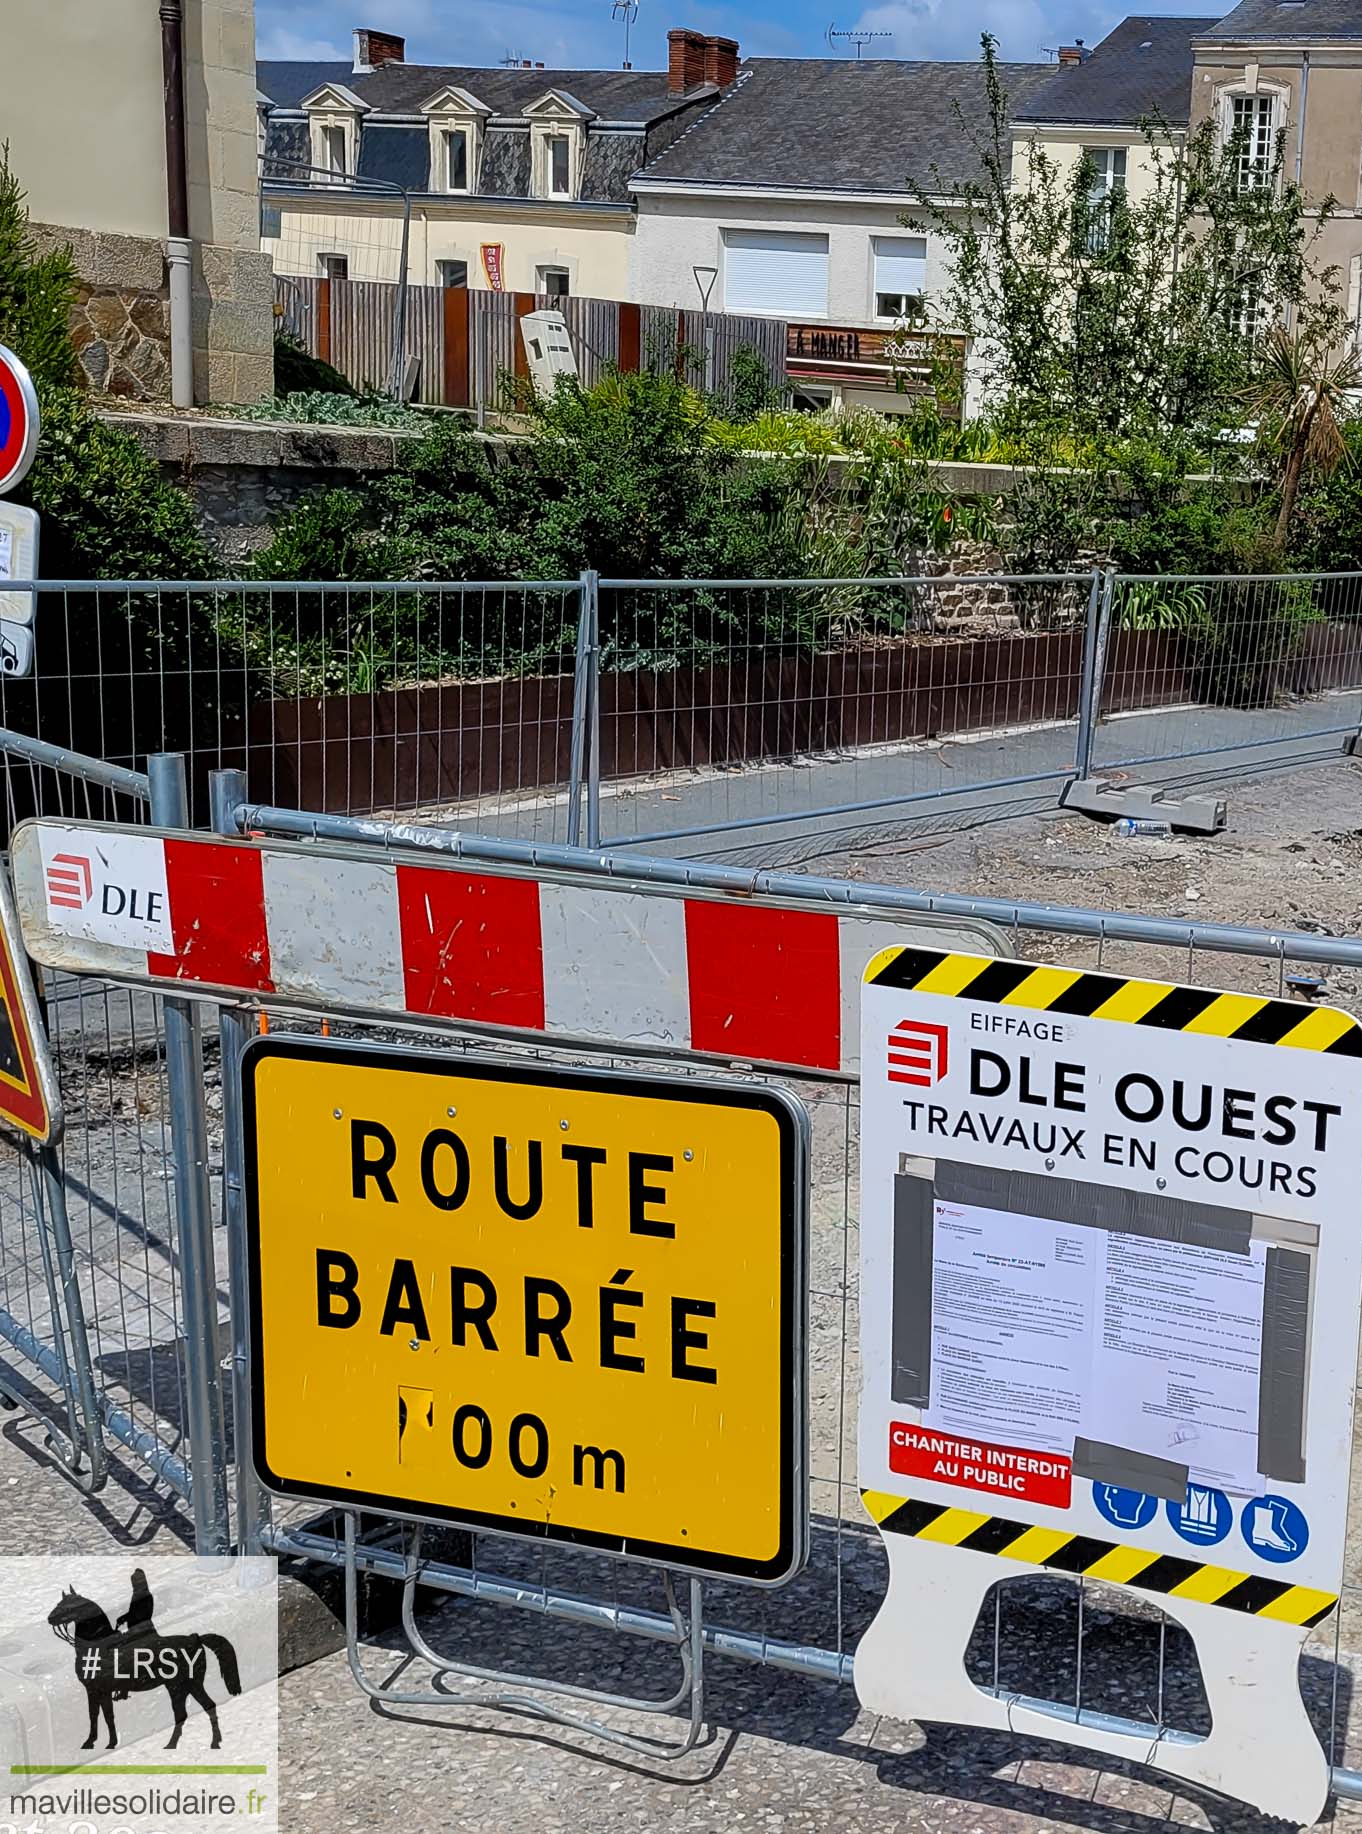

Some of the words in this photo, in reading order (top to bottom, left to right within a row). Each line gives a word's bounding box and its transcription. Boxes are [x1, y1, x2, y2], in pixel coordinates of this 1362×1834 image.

[101, 883, 163, 924] DLE
[970, 1012, 1064, 1043] EIFFAGE
[970, 1048, 1086, 1113] DLE
[1115, 1073, 1342, 1152] OUEST
[350, 1118, 676, 1240] ROUTE
[903, 1100, 1086, 1160] TRAVAUX
[1104, 1134, 1156, 1171] EN
[1175, 1147, 1318, 1198] COURS
[315, 1247, 717, 1385] BARRÉE
[892, 1430, 983, 1463] CHANTIER
[986, 1449, 1069, 1480] INTERDIT
[933, 1459, 960, 1478] AU
[963, 1465, 1026, 1493] PUBLIC
